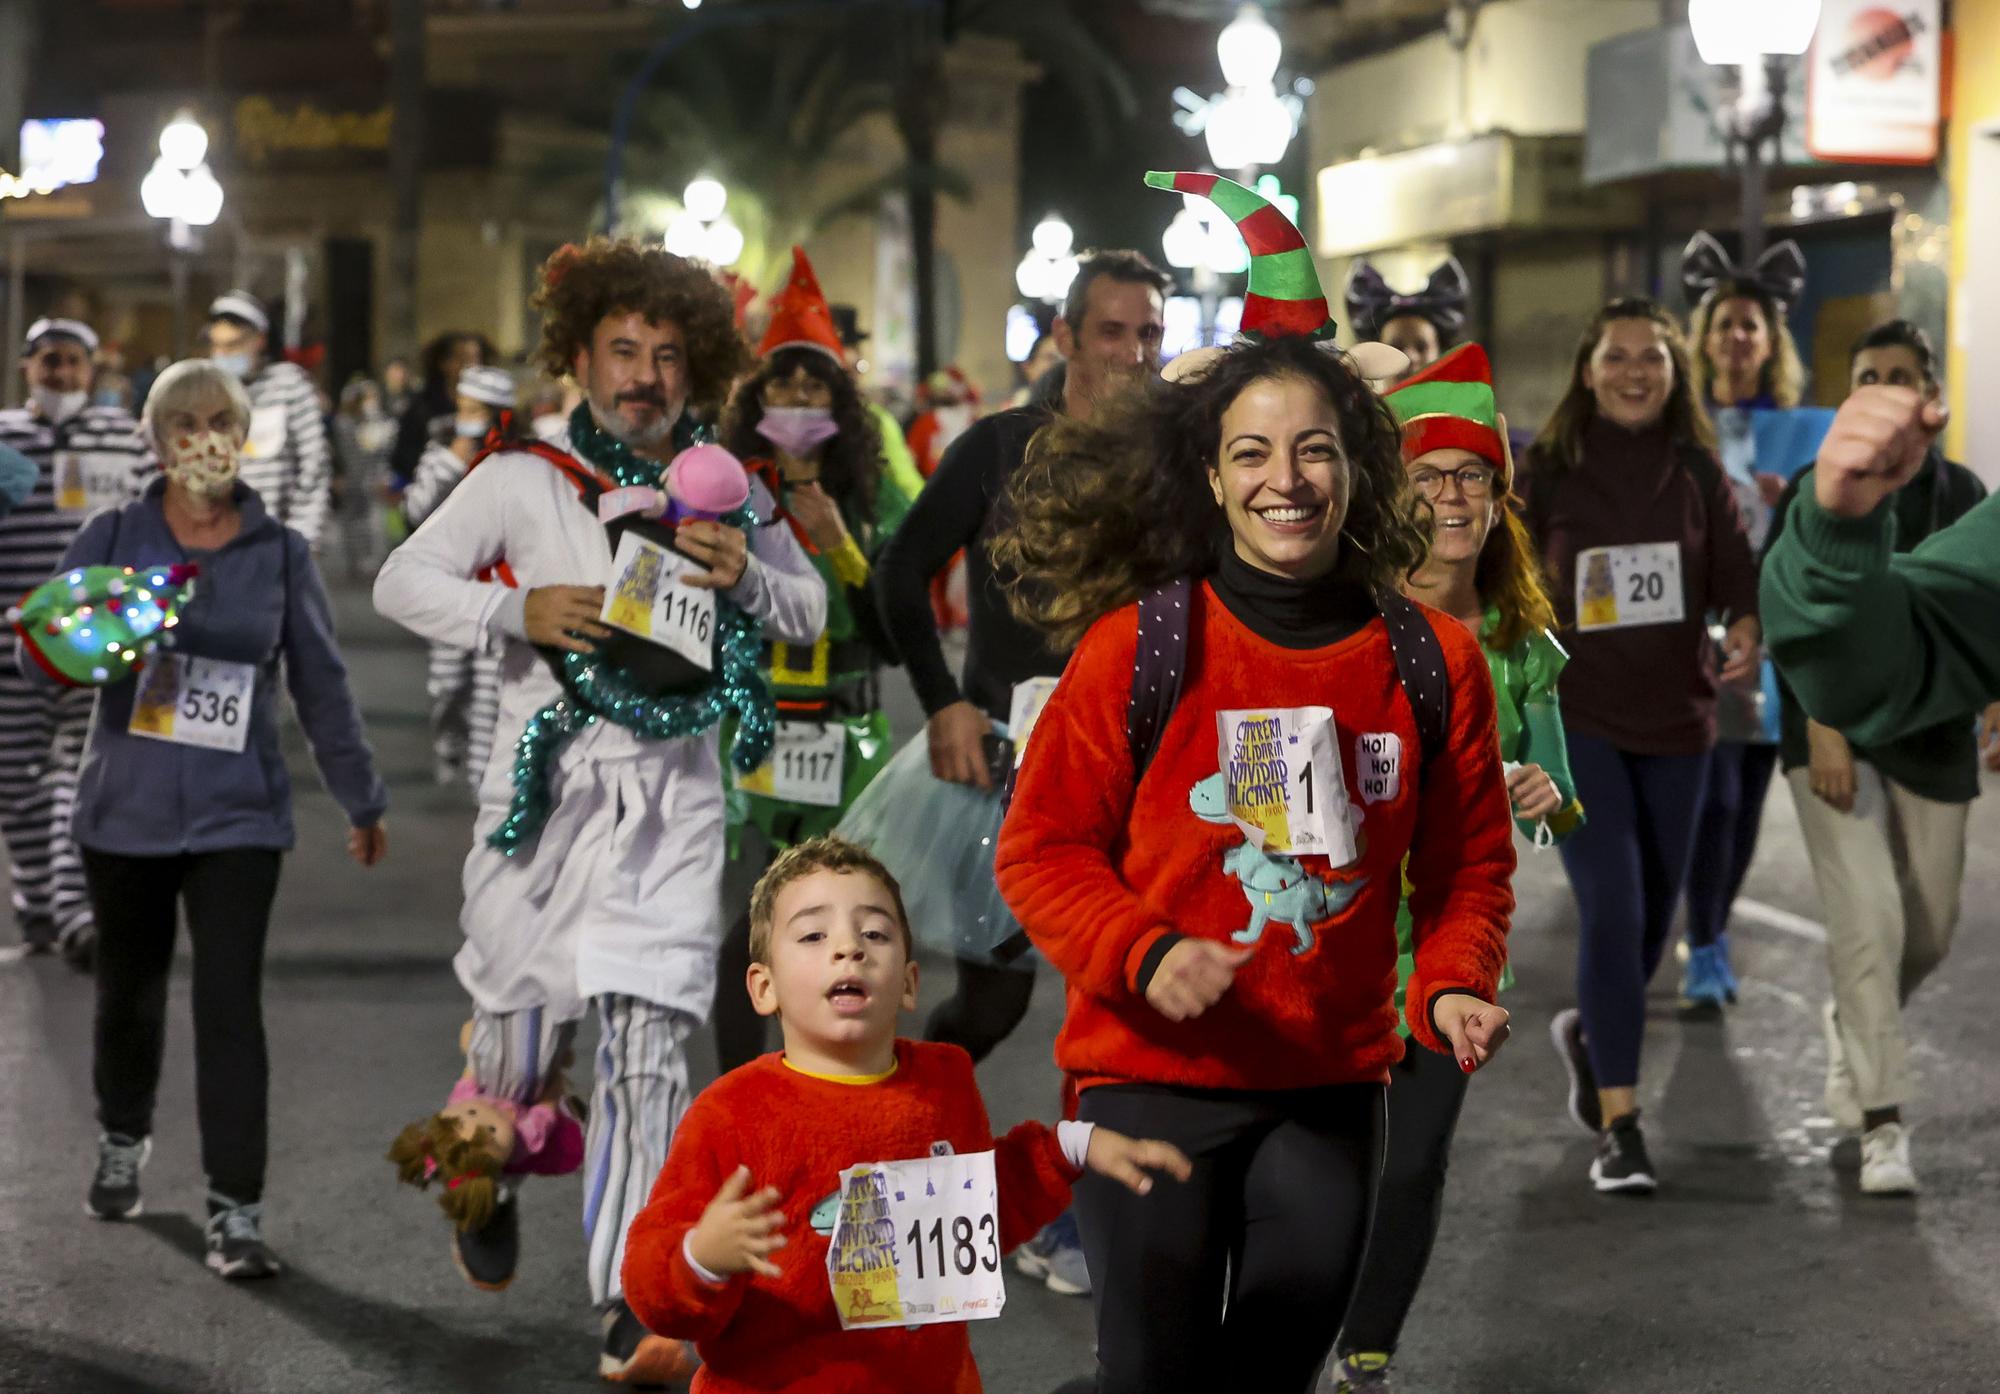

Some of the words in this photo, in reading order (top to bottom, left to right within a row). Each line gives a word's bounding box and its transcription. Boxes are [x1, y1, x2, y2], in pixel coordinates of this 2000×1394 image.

[1628, 571, 1664, 603] 20
[662, 591, 711, 642] 1116
[183, 687, 240, 727] 536
[1236, 717, 1282, 741] CARRERA
[1233, 740, 1284, 763] SOLIDARIA
[1361, 736, 1386, 753] HO!
[783, 749, 834, 782] 1117
[1229, 759, 1288, 785] NAVIDAD
[1371, 757, 1396, 774] HO!
[1229, 782, 1291, 807] ALICANTE
[1298, 761, 1314, 814] 1
[1364, 777, 1388, 795] HO!
[907, 1213, 998, 1280] 1183
